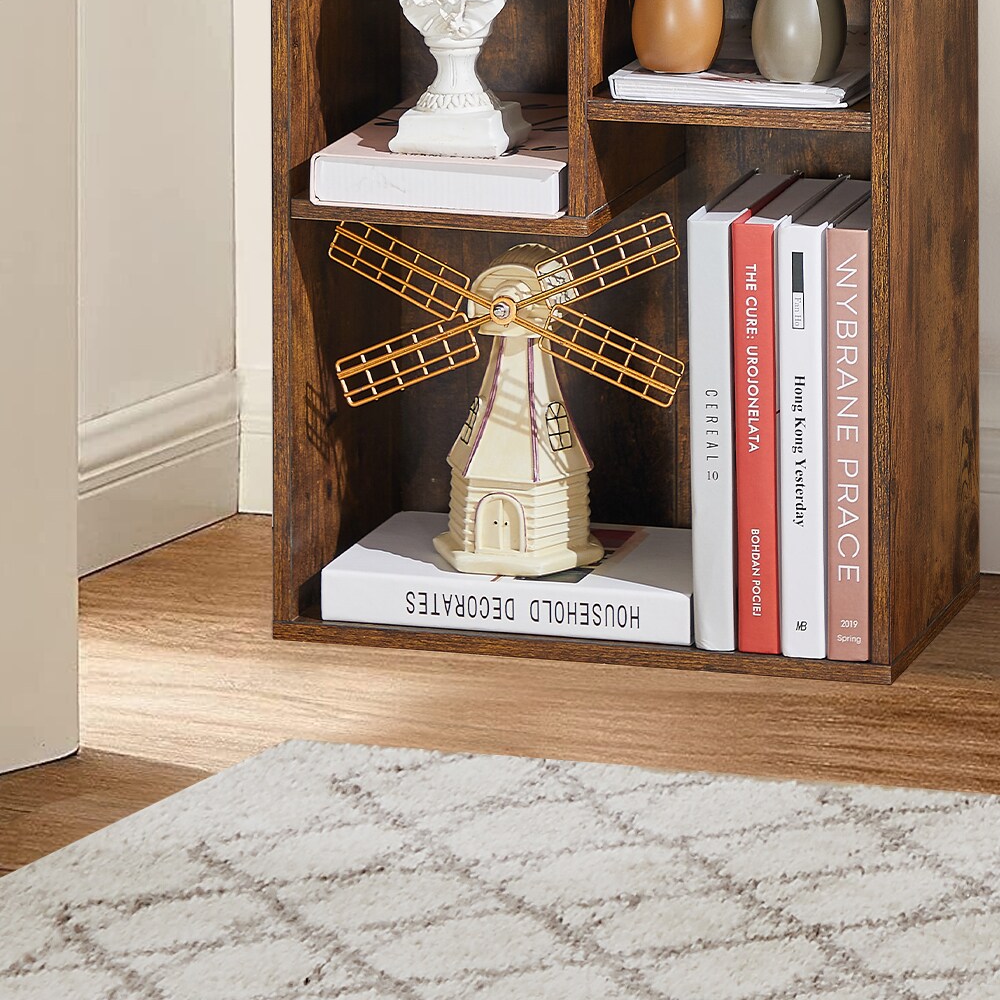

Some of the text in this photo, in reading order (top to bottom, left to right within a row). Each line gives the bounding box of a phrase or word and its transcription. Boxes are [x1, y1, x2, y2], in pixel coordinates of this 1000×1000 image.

[745, 264, 760, 453] THE CURE: UROJONELATA
[705, 389, 719, 461] CEREAL
[791, 375, 807, 527] Hong Kong Yesterday
[836, 253, 860, 582] WYBRANE PRACE
[405, 591, 641, 629] HOUSEHOLD DECORATES
[750, 528, 762, 617] BOHDAN POCIEJ
[836, 634, 862, 645] Spring
[840, 620, 859, 628] 2019
